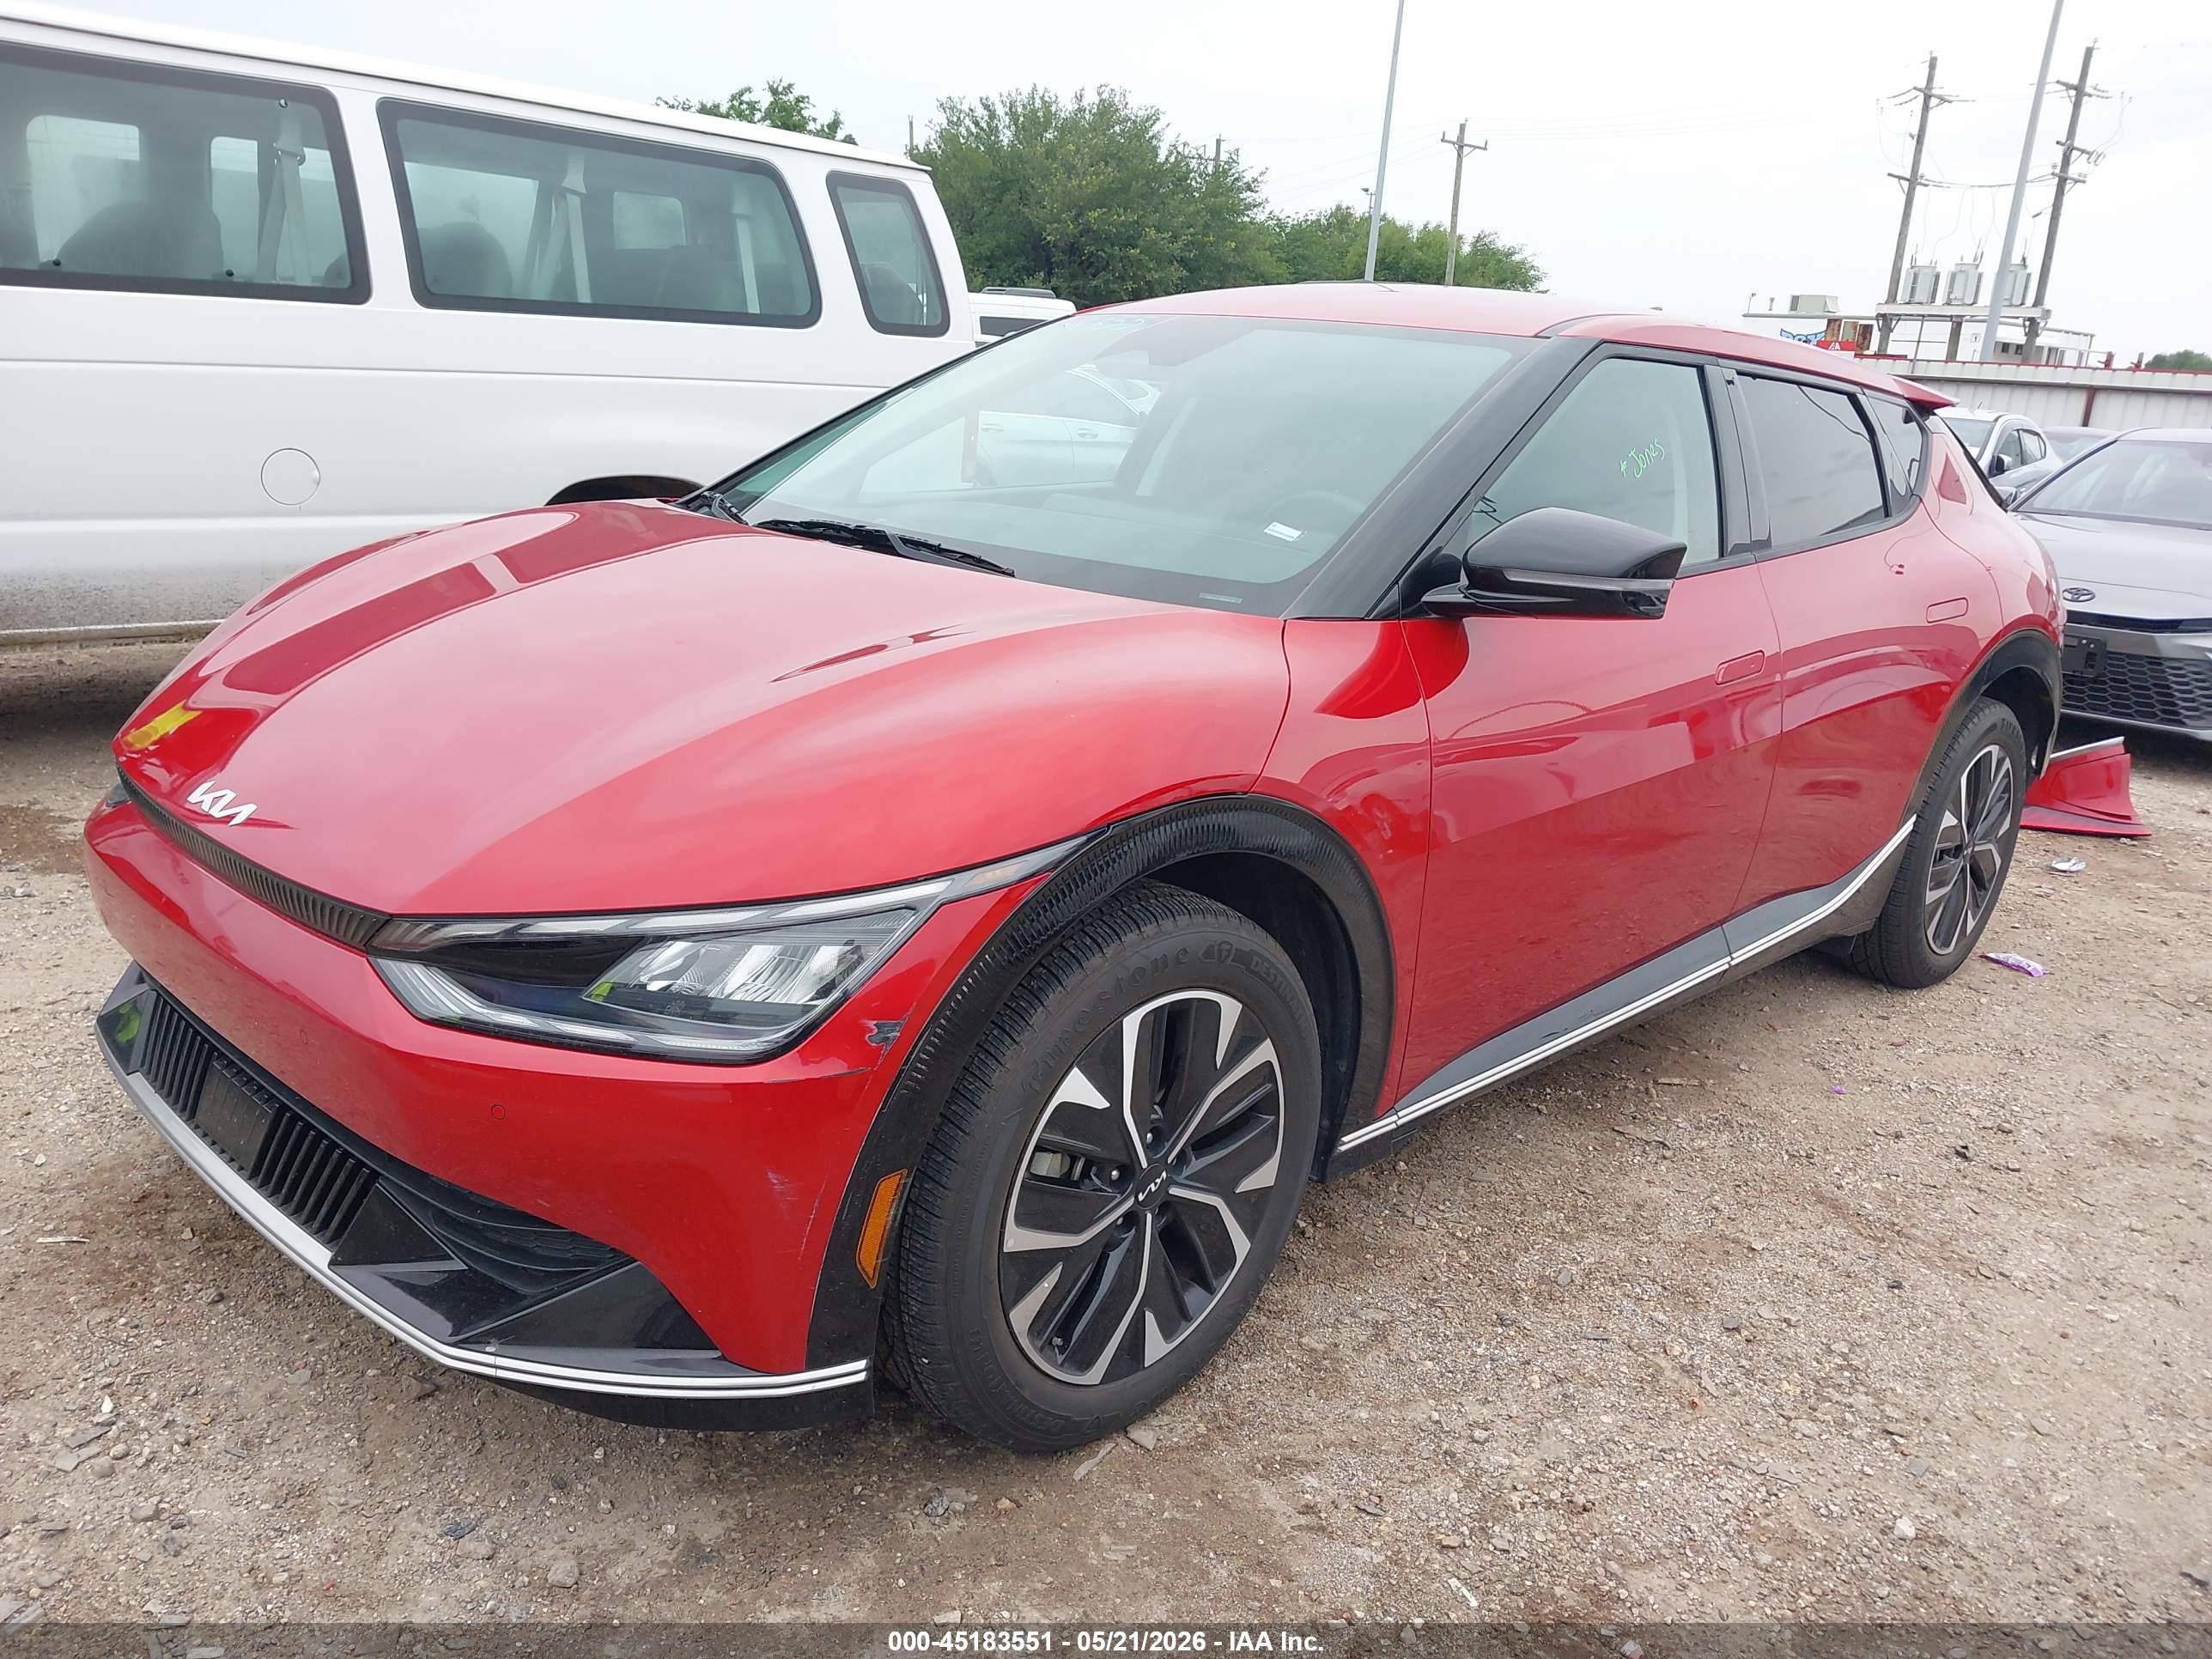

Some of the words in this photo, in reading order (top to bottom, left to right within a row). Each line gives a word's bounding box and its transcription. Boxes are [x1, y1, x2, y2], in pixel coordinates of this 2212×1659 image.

[1628, 439, 1666, 478] Jones
[185, 780, 258, 827] KIA
[1137, 1170, 1167, 1202] KIA
